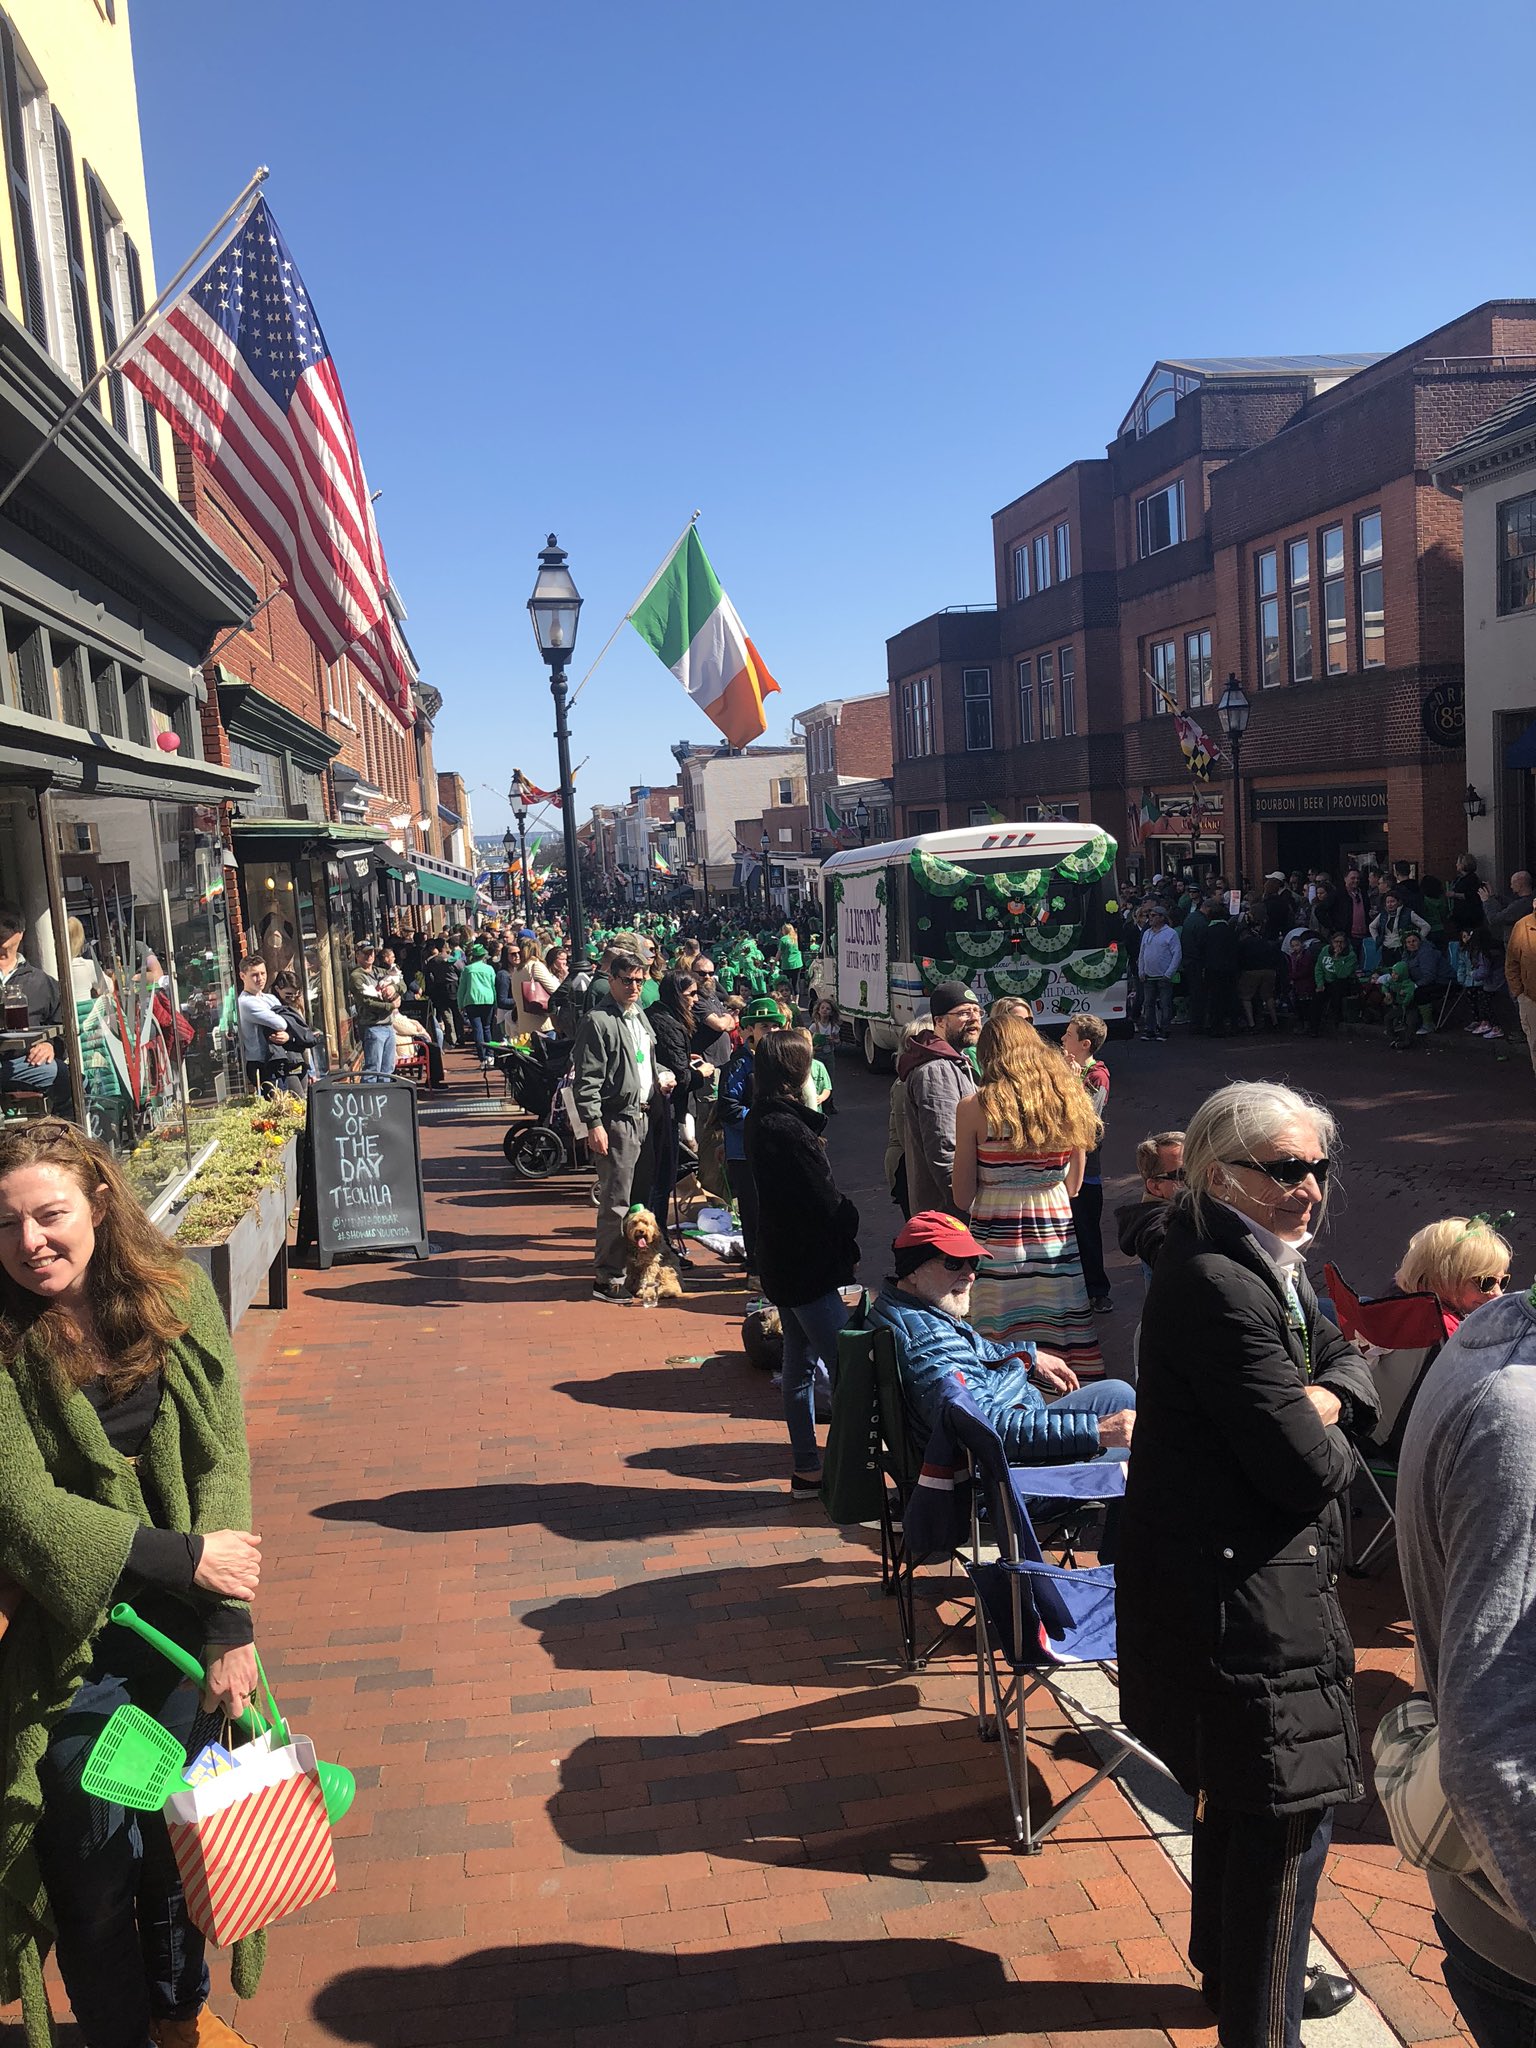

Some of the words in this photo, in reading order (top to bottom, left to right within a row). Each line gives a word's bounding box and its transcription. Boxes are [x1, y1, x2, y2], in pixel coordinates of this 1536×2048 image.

[1440, 705, 1464, 728] 85
[1256, 797, 1295, 811] BOURBON
[1303, 796, 1324, 809] BEER
[331, 1092, 388, 1118] SOUP
[345, 1116, 369, 1136] OF
[335, 1134, 380, 1157] THE
[340, 1154, 384, 1182] DAY
[329, 1184, 392, 1209] TEQUILA
